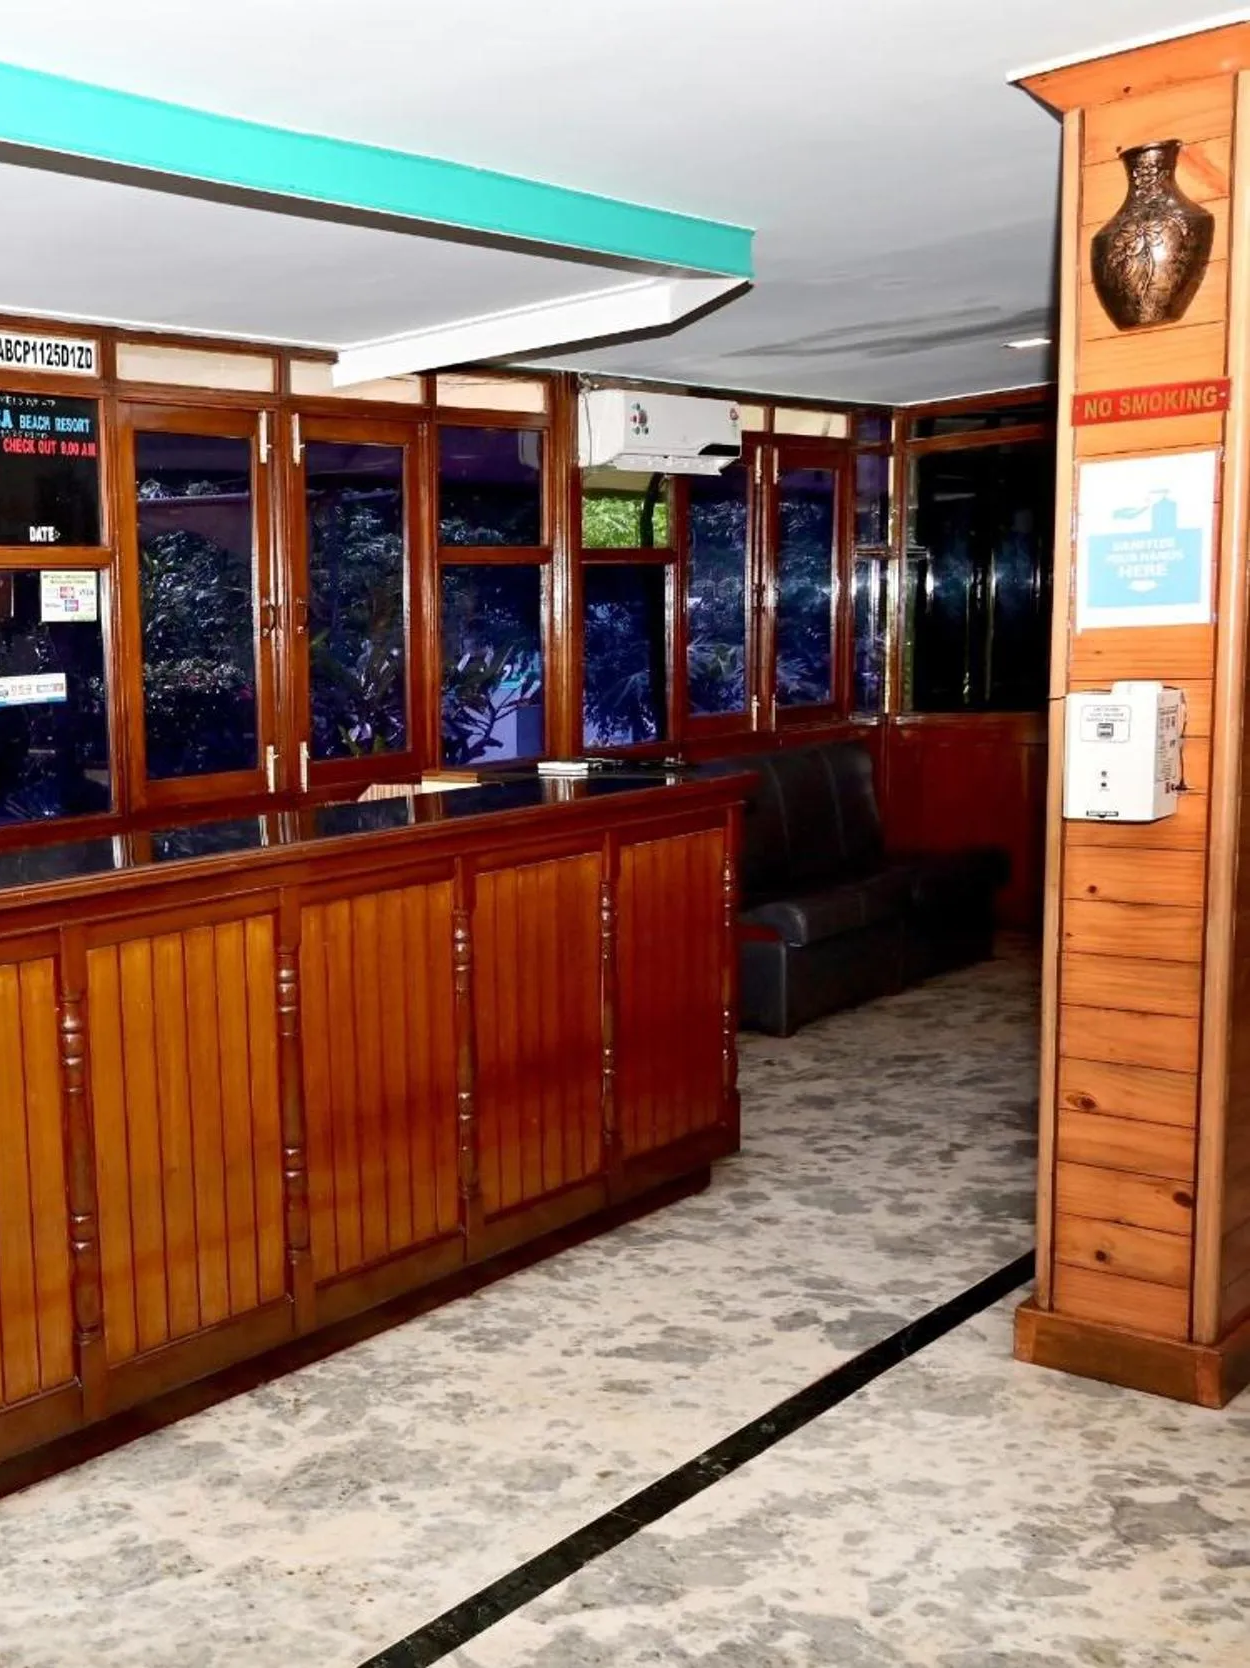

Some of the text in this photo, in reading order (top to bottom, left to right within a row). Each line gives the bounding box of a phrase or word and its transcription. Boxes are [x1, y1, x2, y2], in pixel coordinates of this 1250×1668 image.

[1084, 385, 1218, 420] NO SMOKING
[19, 414, 51, 431] BEACH
[55, 416, 91, 434] RESORT
[2, 437, 36, 454] CHECK
[38, 439, 57, 455] OUT
[1116, 563, 1170, 579] HERE
